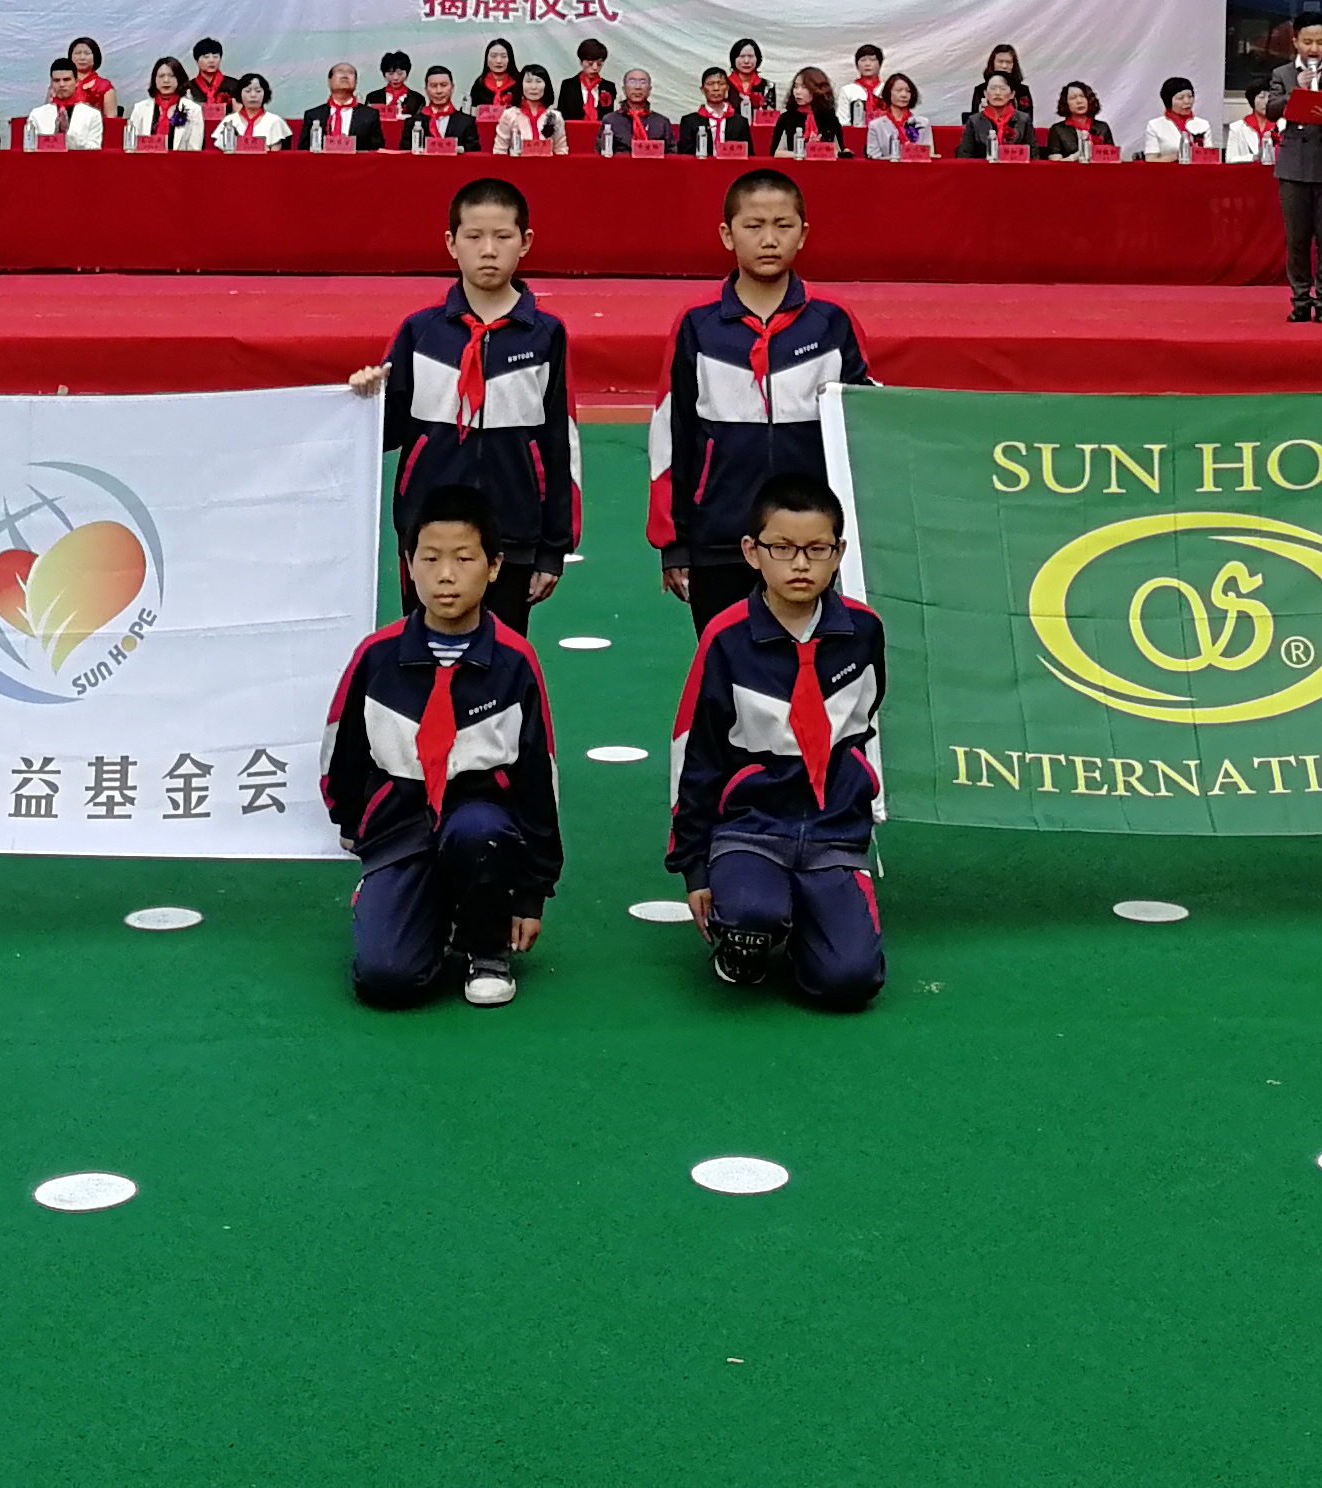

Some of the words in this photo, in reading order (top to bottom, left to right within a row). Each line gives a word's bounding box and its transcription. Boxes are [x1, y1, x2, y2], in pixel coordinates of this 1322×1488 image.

[991, 440, 1168, 495] SUN
[71, 660, 114, 696] SUN
[107, 606, 158, 666] HOPE
